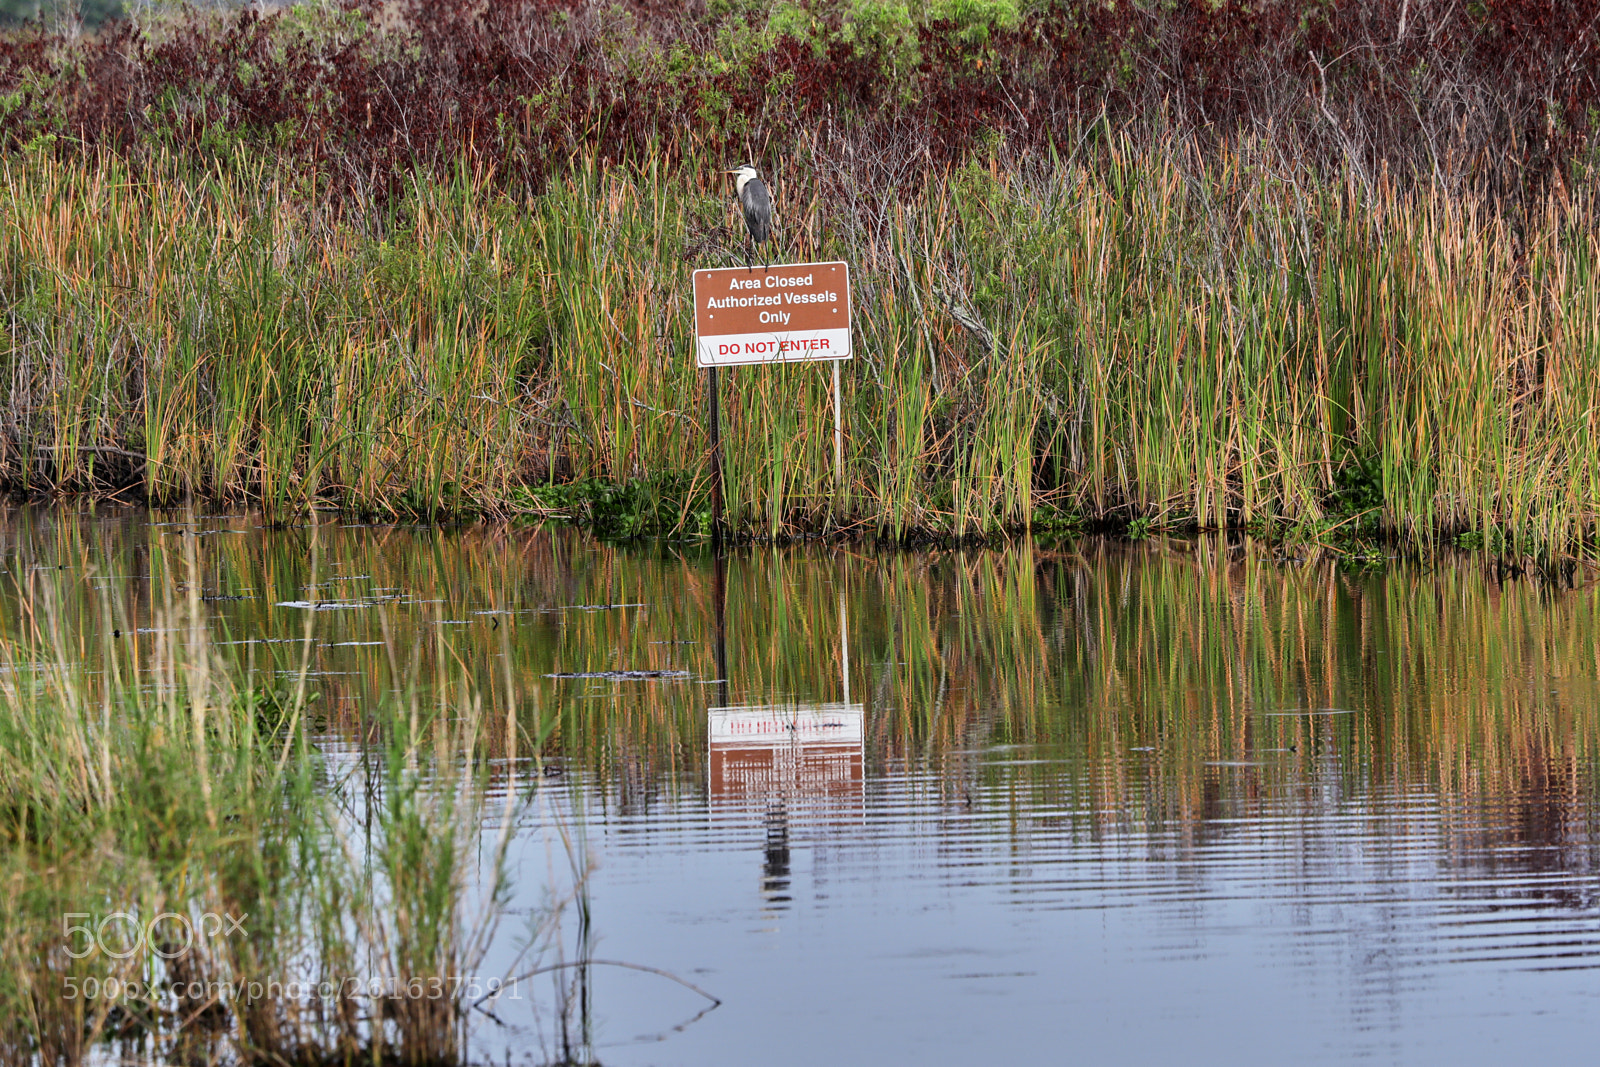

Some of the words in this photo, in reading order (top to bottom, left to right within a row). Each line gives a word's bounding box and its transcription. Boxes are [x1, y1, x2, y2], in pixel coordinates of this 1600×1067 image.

[729, 278, 761, 290] Area
[765, 273, 813, 288] Closed
[707, 293, 781, 309] Authorized
[784, 290, 837, 305] Vessels
[759, 310, 791, 325] Only
[719, 343, 740, 355] DO
[745, 341, 776, 354] NOT
[780, 338, 830, 352] ENTER
